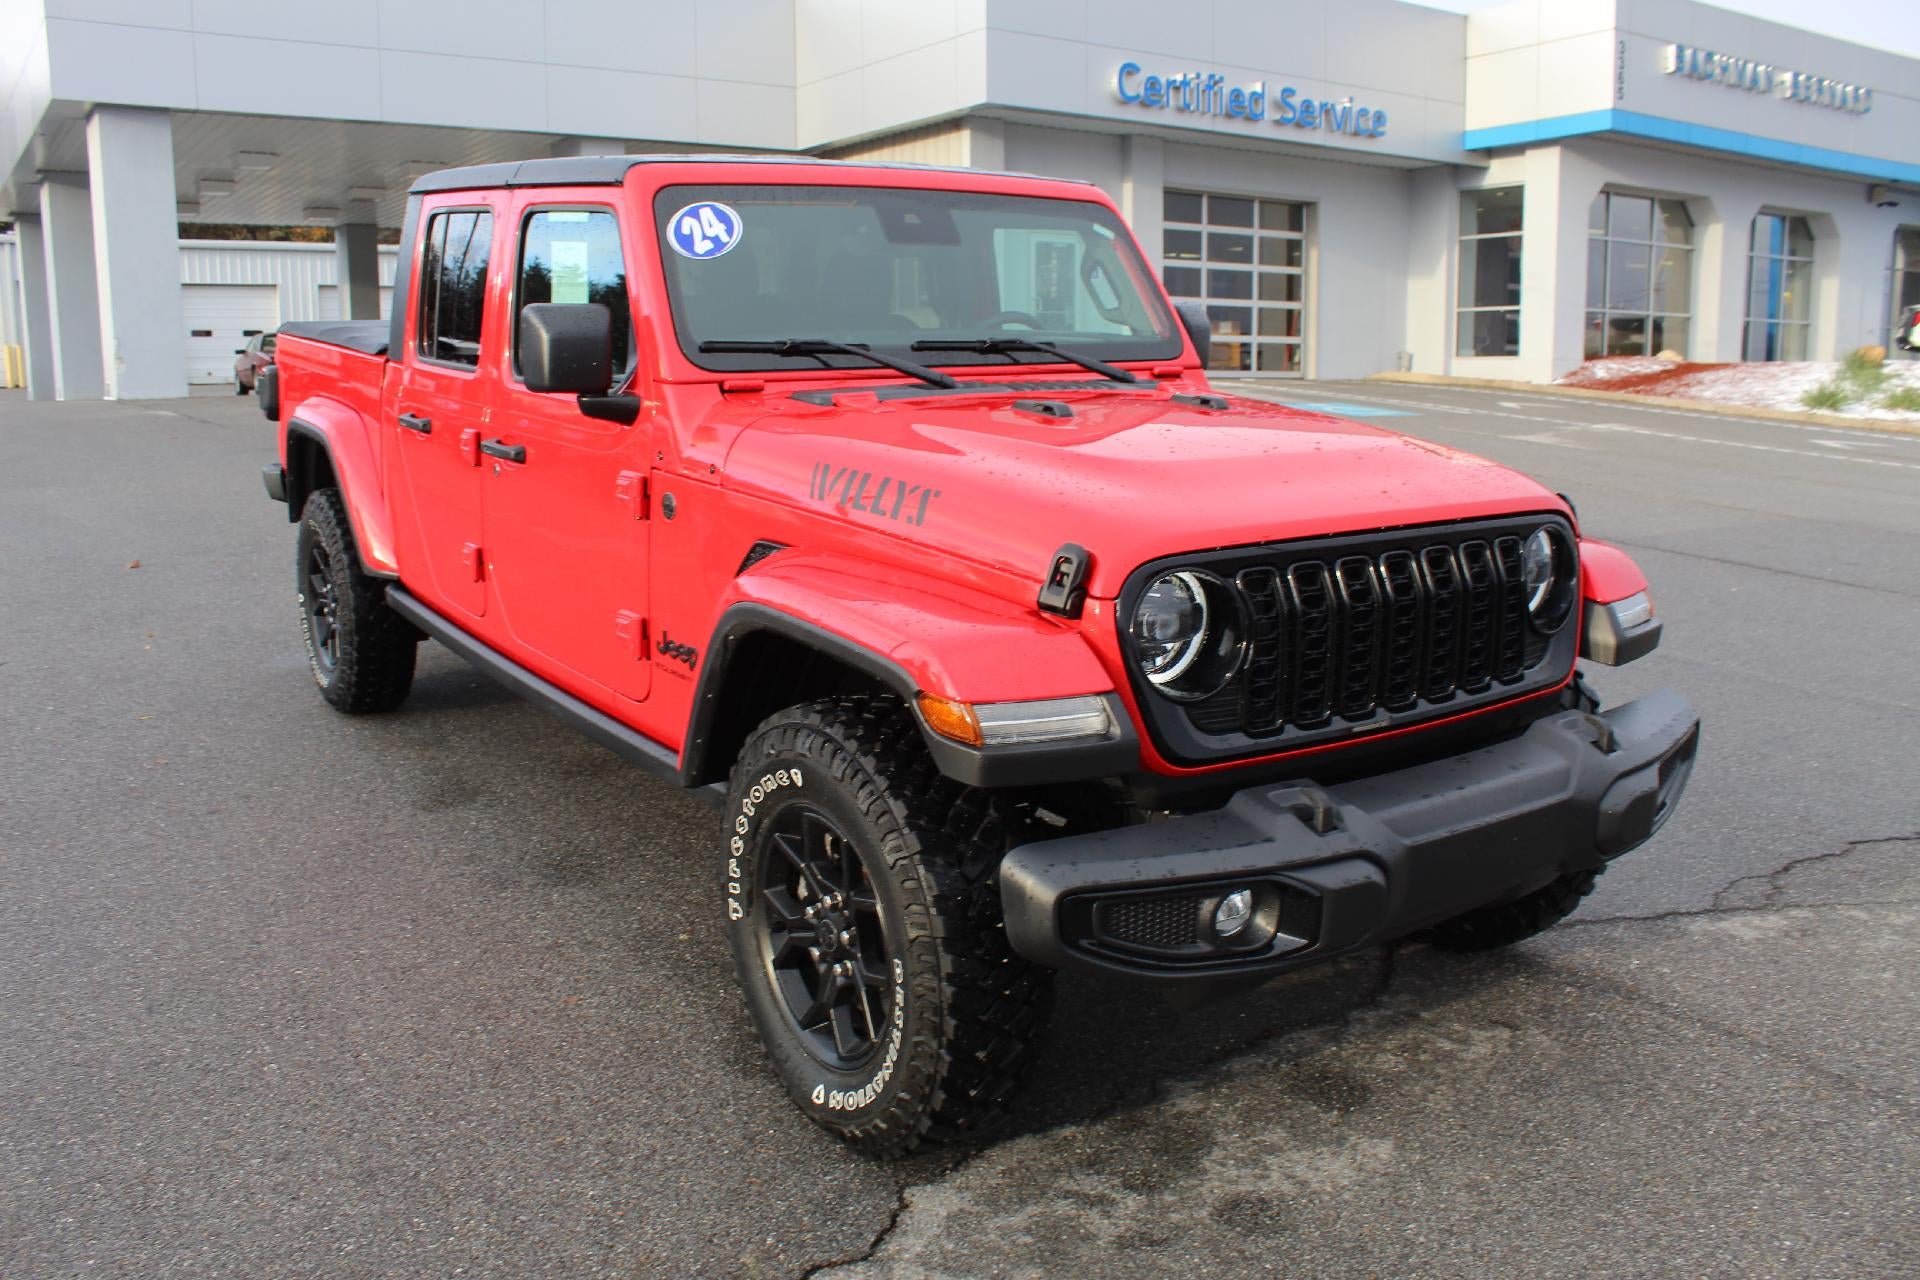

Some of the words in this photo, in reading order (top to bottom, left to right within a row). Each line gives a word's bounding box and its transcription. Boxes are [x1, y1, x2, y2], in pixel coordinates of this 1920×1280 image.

[1117, 62, 1267, 121] Certified
[1279, 86, 1387, 137] Service
[681, 206, 730, 255] 24
[810, 461, 942, 527] WILLYS
[656, 630, 699, 672] Jeep
